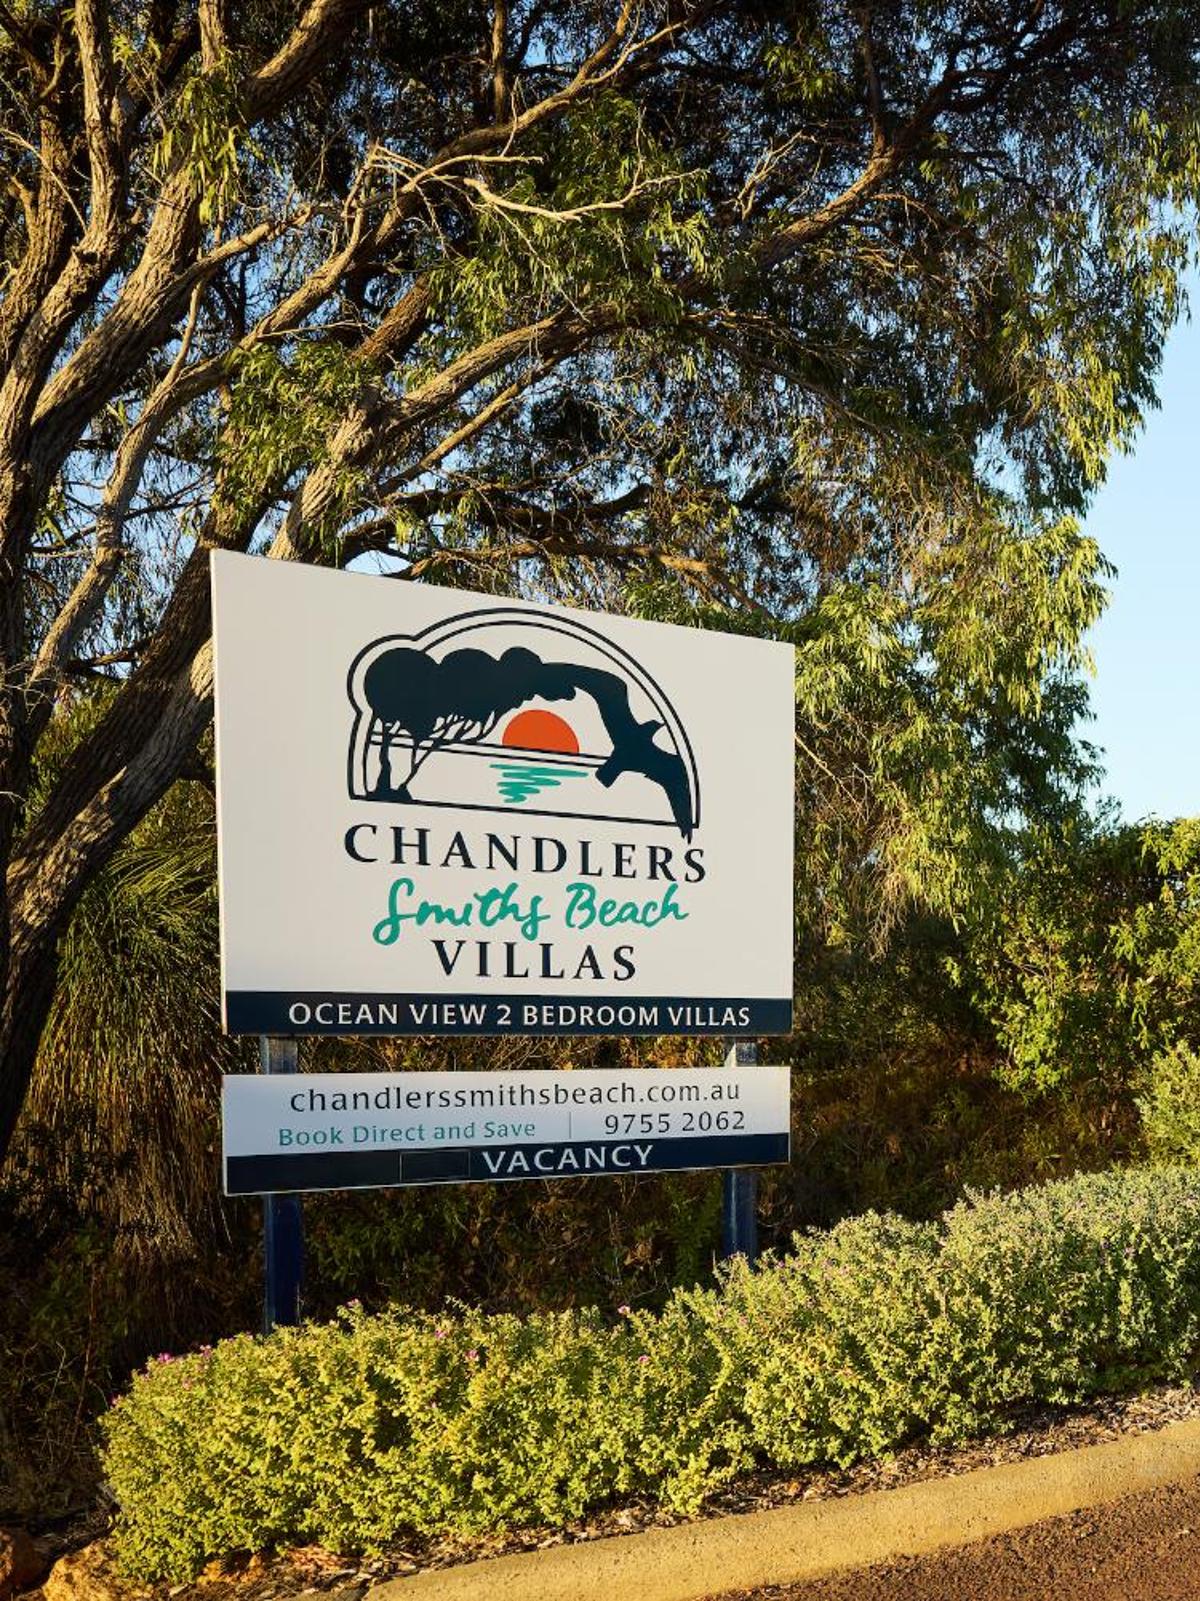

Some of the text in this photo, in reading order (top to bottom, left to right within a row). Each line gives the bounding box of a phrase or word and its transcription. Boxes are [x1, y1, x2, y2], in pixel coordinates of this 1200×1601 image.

[344, 823, 707, 883] CHANDLERS
[372, 878, 688, 945] Smiths Beach
[433, 939, 637, 981] VILLAS
[289, 1003, 750, 1027] OCEAN VIEW 2 BEDROOM VILLAS
[291, 1081, 740, 1112] chandlerssmithsbeach.com.au
[279, 1120, 535, 1147] Book Direct and Save
[604, 1111, 746, 1135] 9755 2062
[482, 1145, 653, 1174] VACANCY
